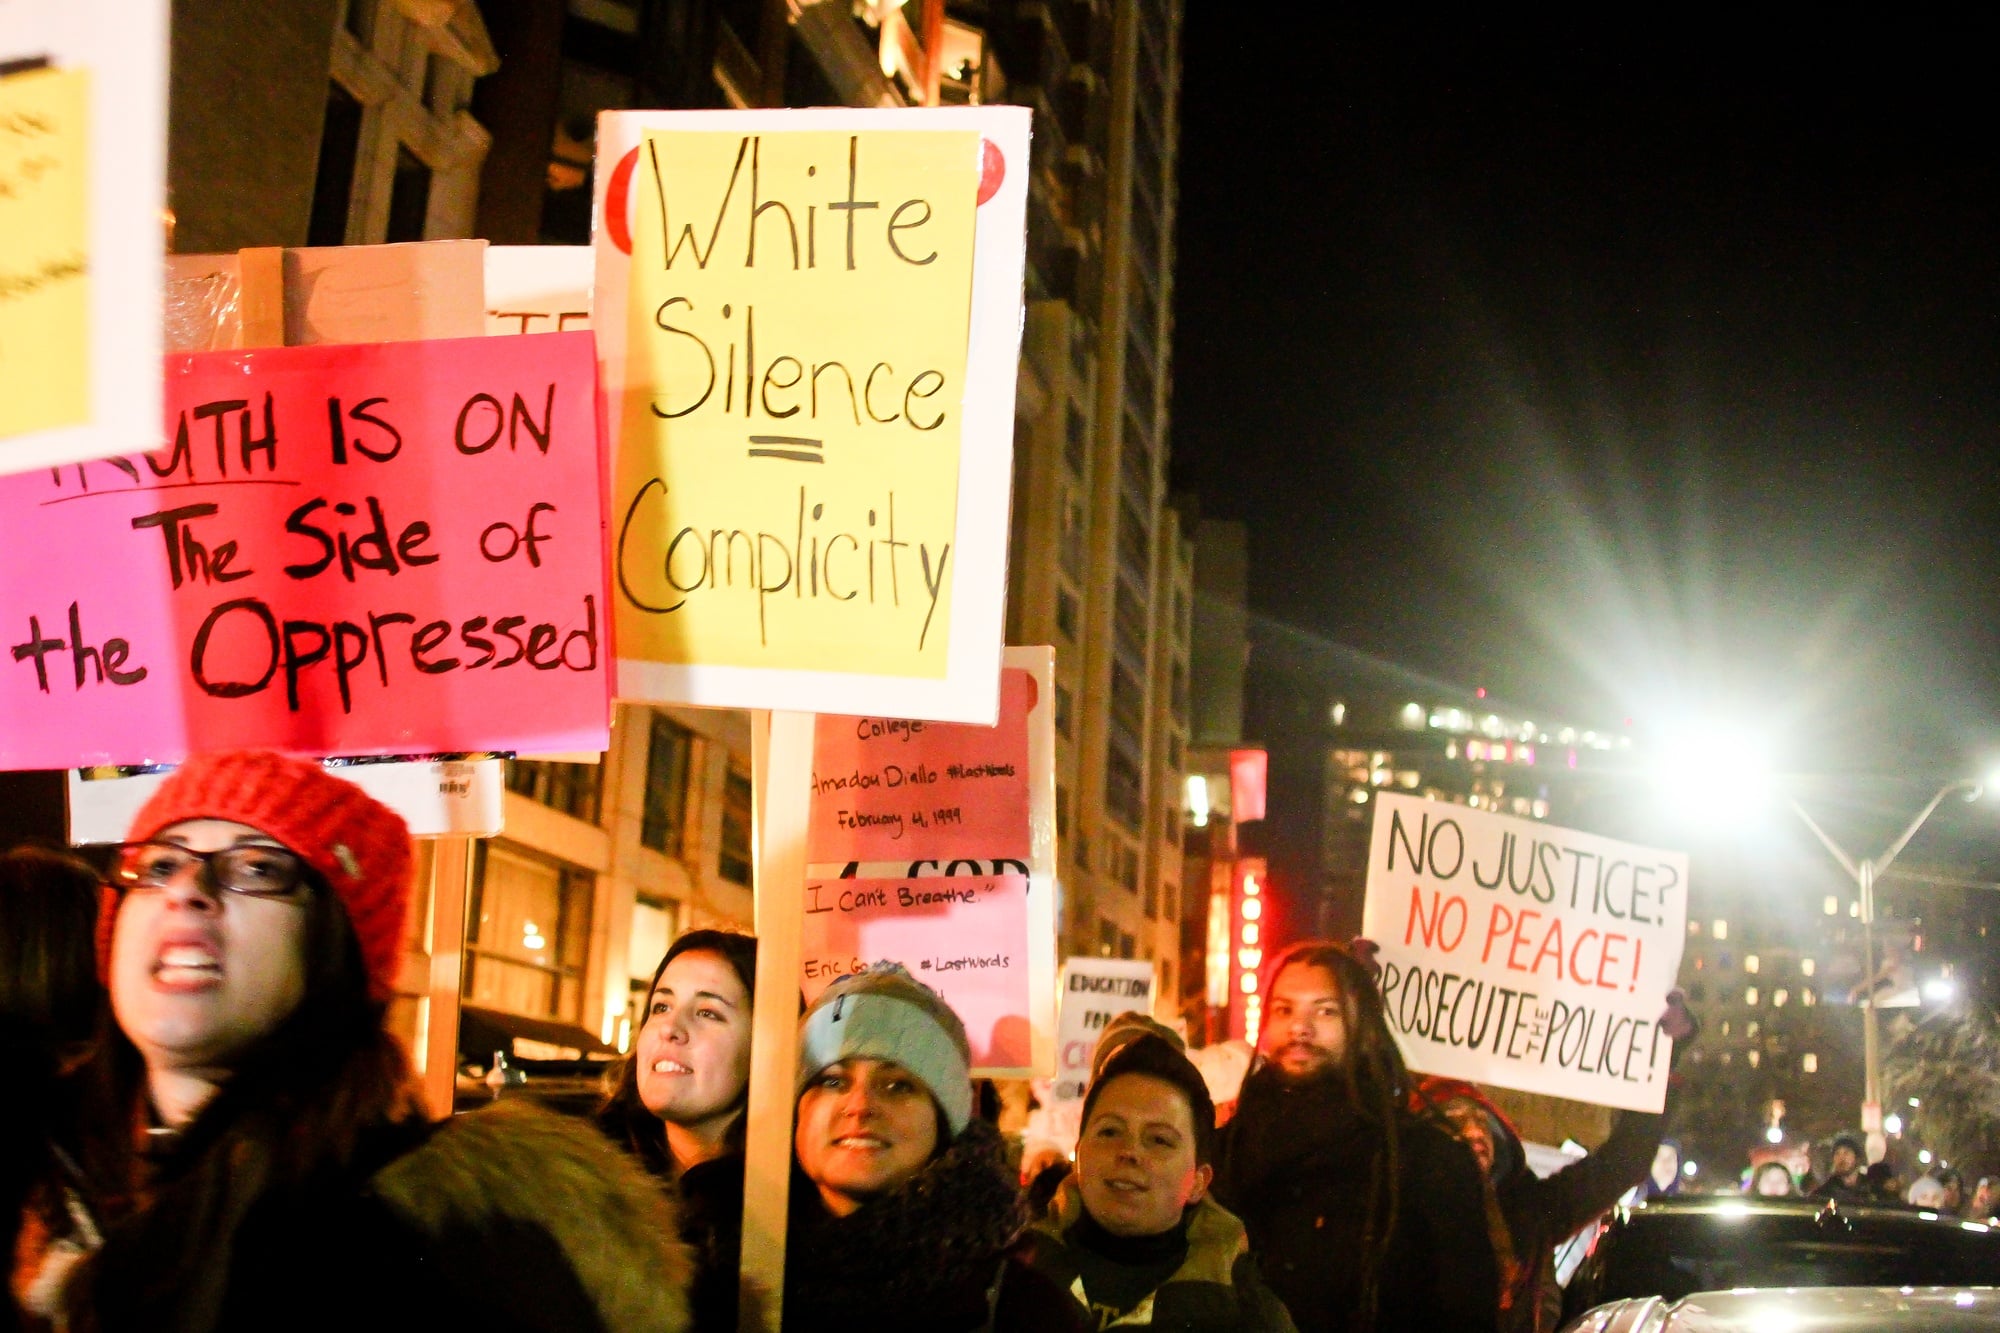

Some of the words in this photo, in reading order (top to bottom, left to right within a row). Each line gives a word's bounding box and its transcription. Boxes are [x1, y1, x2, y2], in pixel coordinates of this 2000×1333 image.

[648, 135, 938, 271] White
[650, 296, 946, 431] Silence
[50, 389, 279, 494] UTH
[328, 396, 403, 465] IS
[455, 383, 557, 456] ON
[132, 503, 252, 592] The
[284, 495, 440, 583] Side
[480, 502, 558, 569] of
[617, 477, 950, 651] Complicity
[12, 601, 149, 695] the
[191, 595, 597, 715] Oppressed
[811, 769, 881, 797] Amadou
[883, 763, 938, 788] Diallo
[837, 809, 904, 840] February
[932, 806, 962, 825] 1999
[806, 884, 834, 914] I
[1387, 808, 1466, 881] NO
[1472, 830, 1680, 928] JUSTICE?
[804, 959, 843, 980] Eric
[1069, 973, 1151, 998] EDUCATION
[1404, 885, 1469, 954] NO
[1481, 902, 1643, 994] PEACE!
[1525, 1007, 1550, 1054] THE
[1540, 999, 1664, 1084] POLICE!
